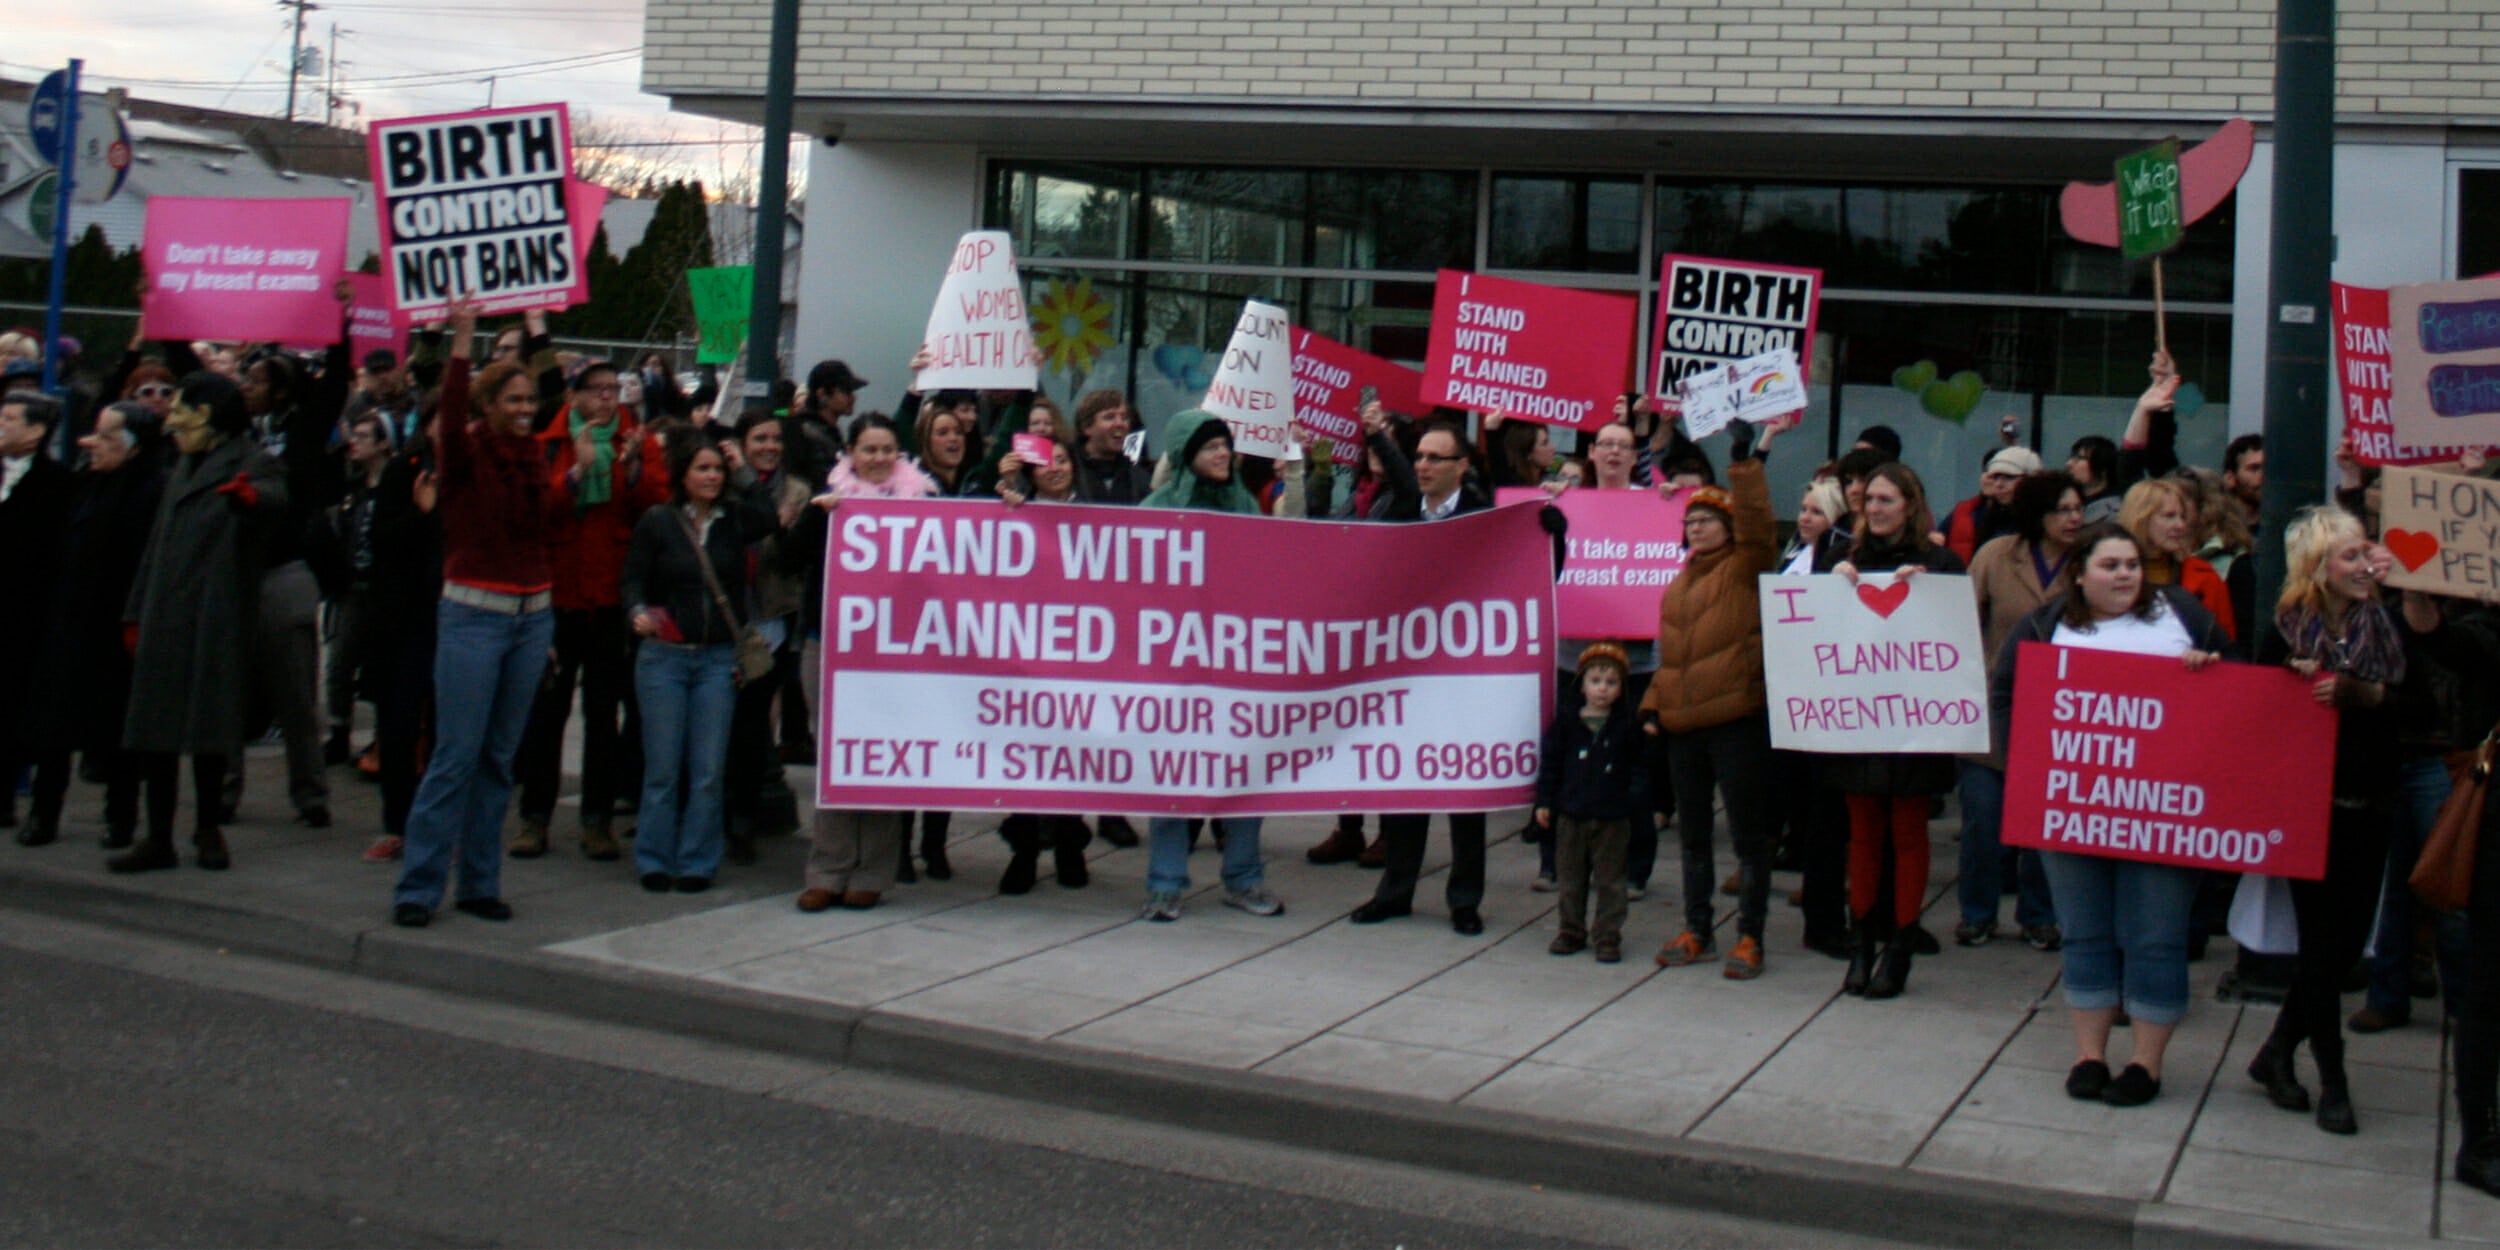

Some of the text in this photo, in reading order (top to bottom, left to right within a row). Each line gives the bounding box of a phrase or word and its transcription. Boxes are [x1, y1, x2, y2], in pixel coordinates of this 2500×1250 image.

[386, 117, 557, 189] BIRTH
[393, 184, 564, 238] CONTROL
[166, 243, 319, 269] Don't take away
[400, 232, 569, 301] NOT BANS
[159, 270, 320, 293] my breast exams
[1461, 275, 1469, 296] I
[1672, 266, 1807, 322] BIRTH
[1457, 302, 1525, 332] STAND
[2341, 287, 2347, 314] I
[1300, 333, 1311, 350] I
[1455, 328, 1507, 356] WITH
[2344, 323, 2391, 355] STAN
[1225, 348, 1261, 374] ON
[1292, 354, 1351, 389] STAND
[1451, 354, 1548, 390] PLANNED
[1298, 406, 1357, 438] ANNED
[2442, 520, 2464, 542] IF
[839, 514, 1205, 586] STAND WITH
[1584, 538, 1628, 559] take
[1634, 541, 1687, 563] away
[1624, 568, 1681, 586] exam
[1773, 589, 1815, 624] I
[837, 596, 1541, 675] PLANNED PARENTHOOD!
[1814, 641, 1960, 677] PLANNED
[2057, 649, 2068, 680] I
[977, 688, 1410, 738] SHOW YOUR SUPPORT
[1786, 694, 1980, 733] PARENTHOOD
[2052, 688, 2164, 731] STAND
[836, 738, 940, 778] TEXT
[1002, 742, 1134, 784] STAND
[1150, 749, 1249, 788] WITH
[1351, 743, 1401, 781] TO
[1416, 741, 1538, 780] 69866
[2051, 729, 2136, 769] WITH
[2046, 769, 2205, 817] PLANNED
